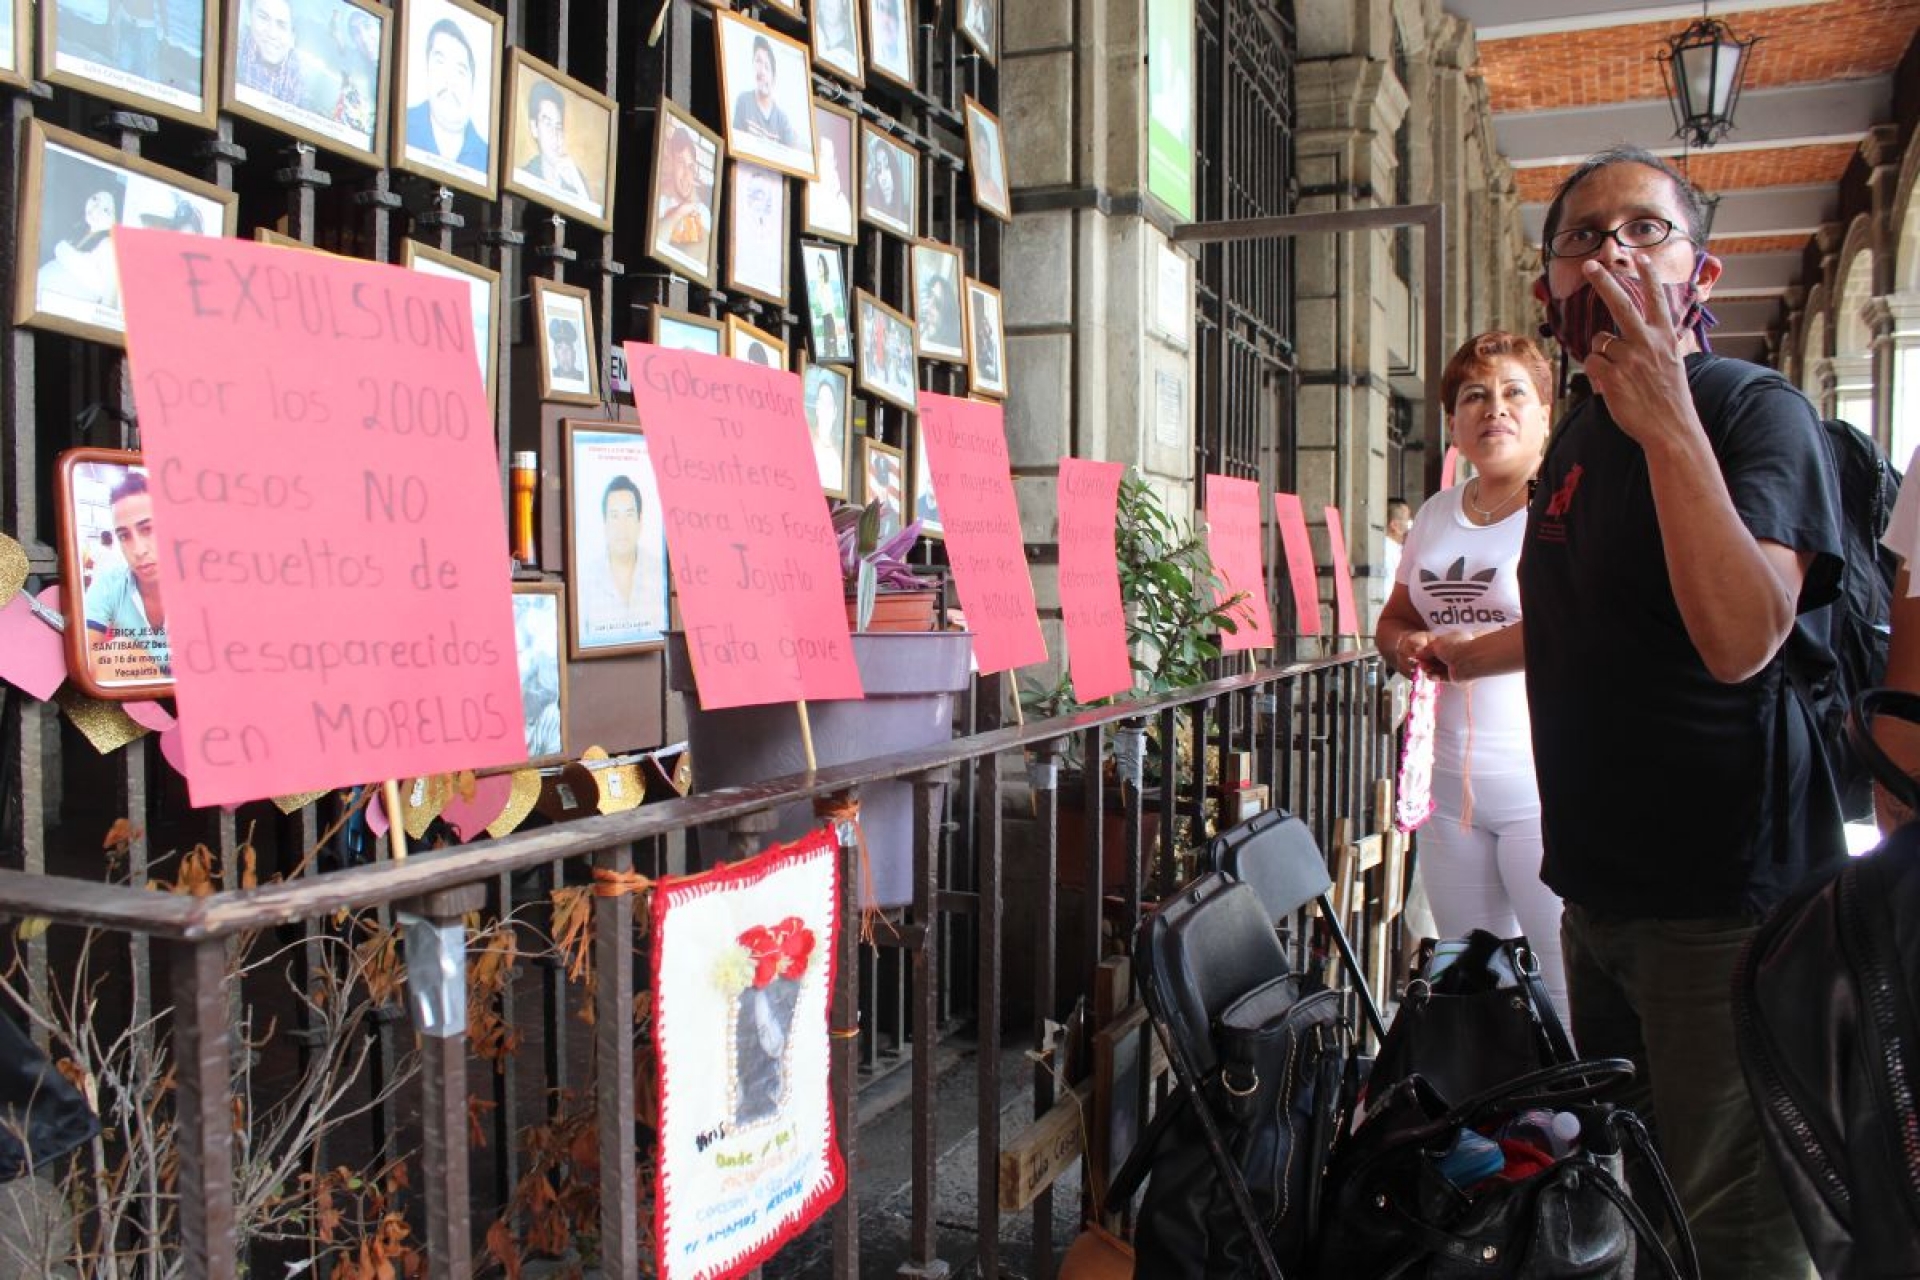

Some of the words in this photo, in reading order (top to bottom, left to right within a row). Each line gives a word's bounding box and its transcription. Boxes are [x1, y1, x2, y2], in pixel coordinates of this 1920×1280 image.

[179, 250, 465, 353] EXPULSION
[145, 368, 238, 427] por
[264, 367, 332, 424] los
[357, 376, 470, 442] 2000
[642, 353, 797, 419] Gobernador
[363, 469, 429, 525] NO
[669, 505, 733, 536] para
[739, 497, 773, 537] las
[173, 536, 386, 590] resueltos
[411, 537, 460, 591] de
[680, 554, 709, 586] de
[109, 627, 136, 637] ERICK
[1429, 605, 1507, 625] adidas
[114, 654, 124, 663] 16
[127, 653, 137, 663] de
[138, 654, 162, 665] mayo
[184, 606, 501, 685] desaparecidos
[202, 725, 271, 768] en
[311, 692, 509, 756] MORELOS
